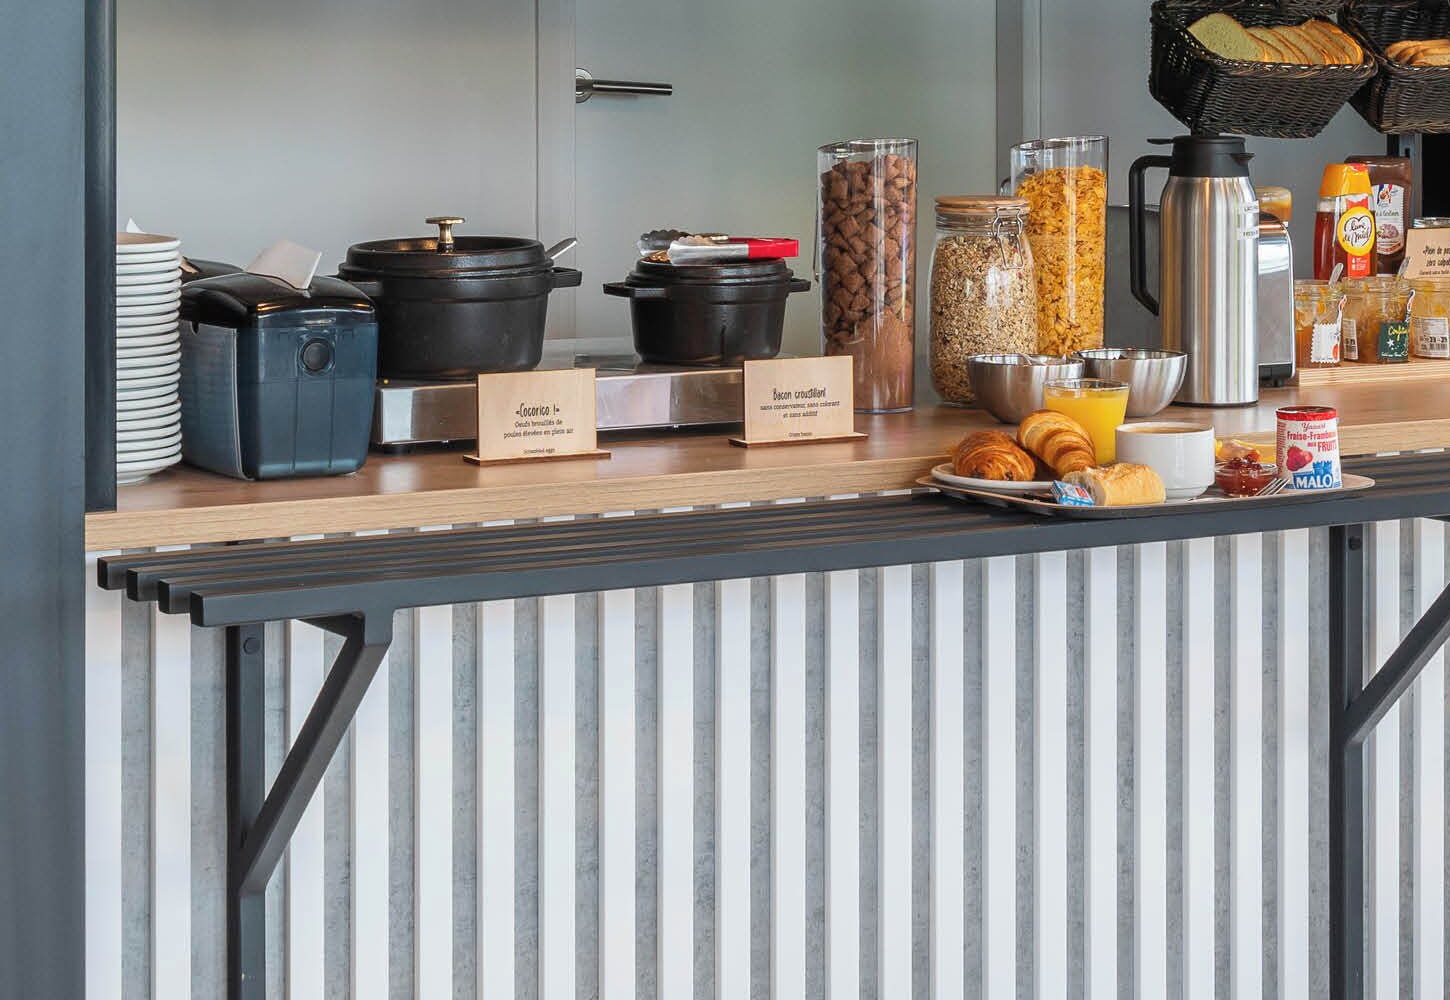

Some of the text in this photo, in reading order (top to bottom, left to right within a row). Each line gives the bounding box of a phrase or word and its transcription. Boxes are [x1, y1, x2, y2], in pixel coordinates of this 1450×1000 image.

[1436, 246, 1442, 255] de
[504, 431, 521, 439] poules
[552, 428, 565, 436] plein
[1296, 474, 1333, 489] MALO
